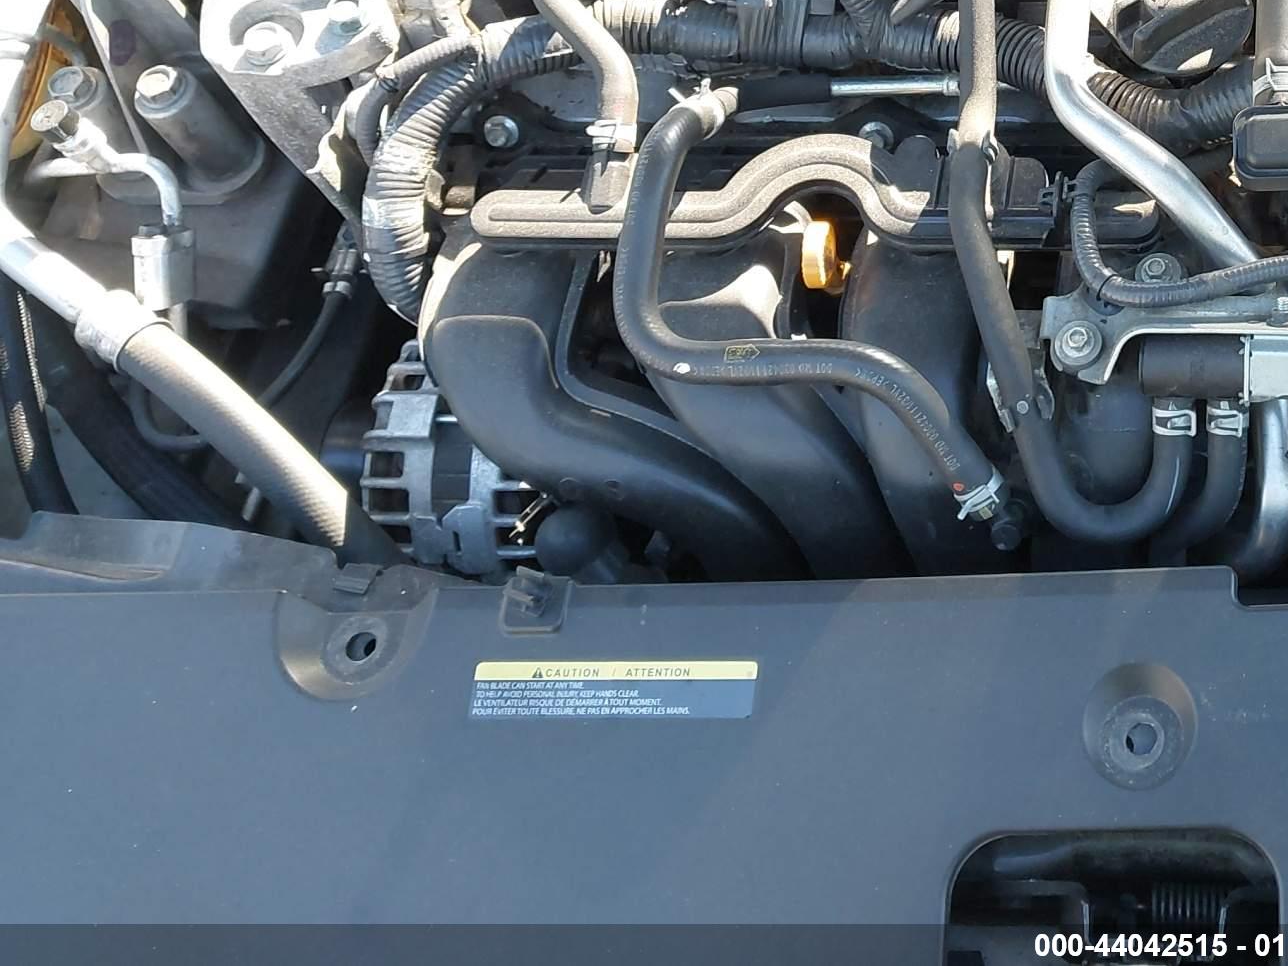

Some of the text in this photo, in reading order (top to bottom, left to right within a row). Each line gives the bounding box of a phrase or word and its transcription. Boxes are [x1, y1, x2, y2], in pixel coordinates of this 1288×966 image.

[545, 667, 600, 678] CAUTION
[625, 667, 691, 678] ATTENTION
[653, 707, 666, 715] LES
